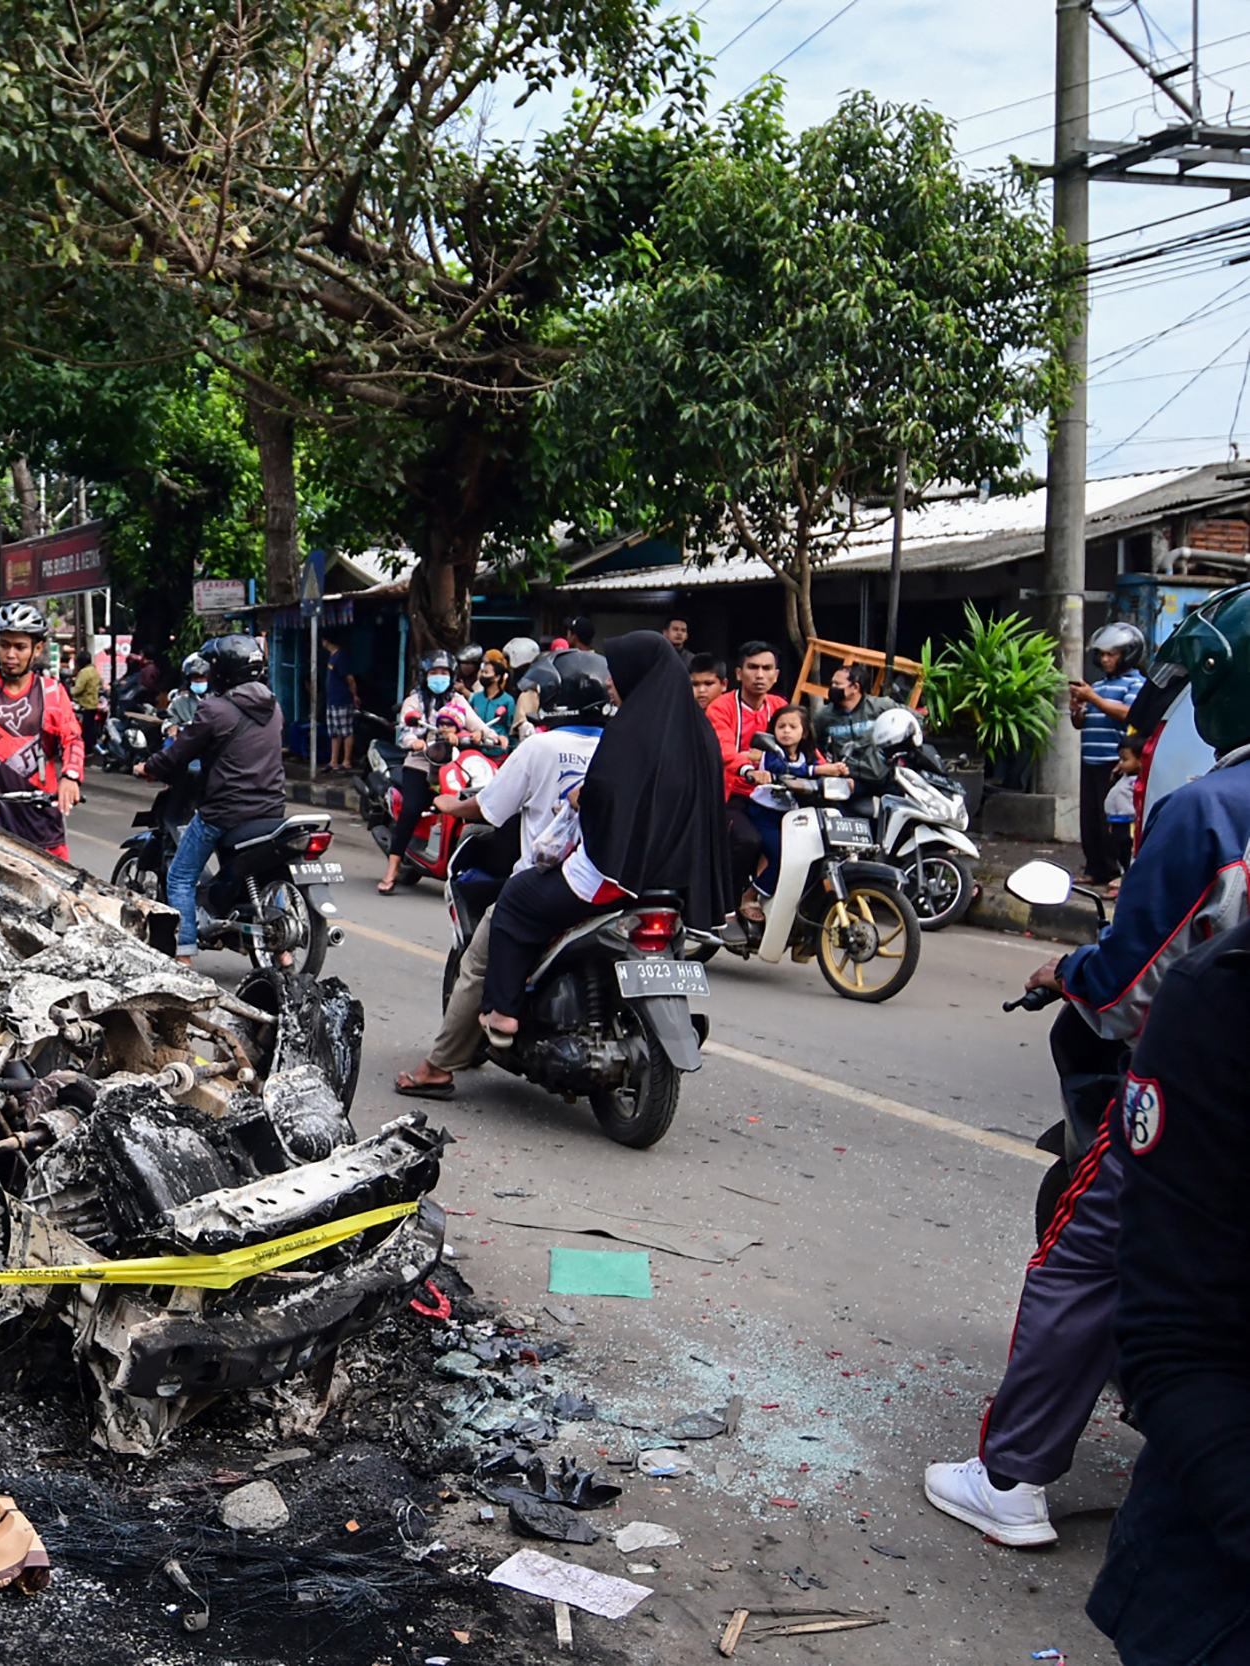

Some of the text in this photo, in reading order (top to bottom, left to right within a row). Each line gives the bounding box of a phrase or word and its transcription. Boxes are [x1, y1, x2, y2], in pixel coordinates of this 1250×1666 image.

[42, 559, 53, 577] POS
[54, 554, 75, 576] BUBUR
[558, 753, 591, 766] BEN
[617, 964, 628, 980] N
[637, 964, 672, 978] 3023
